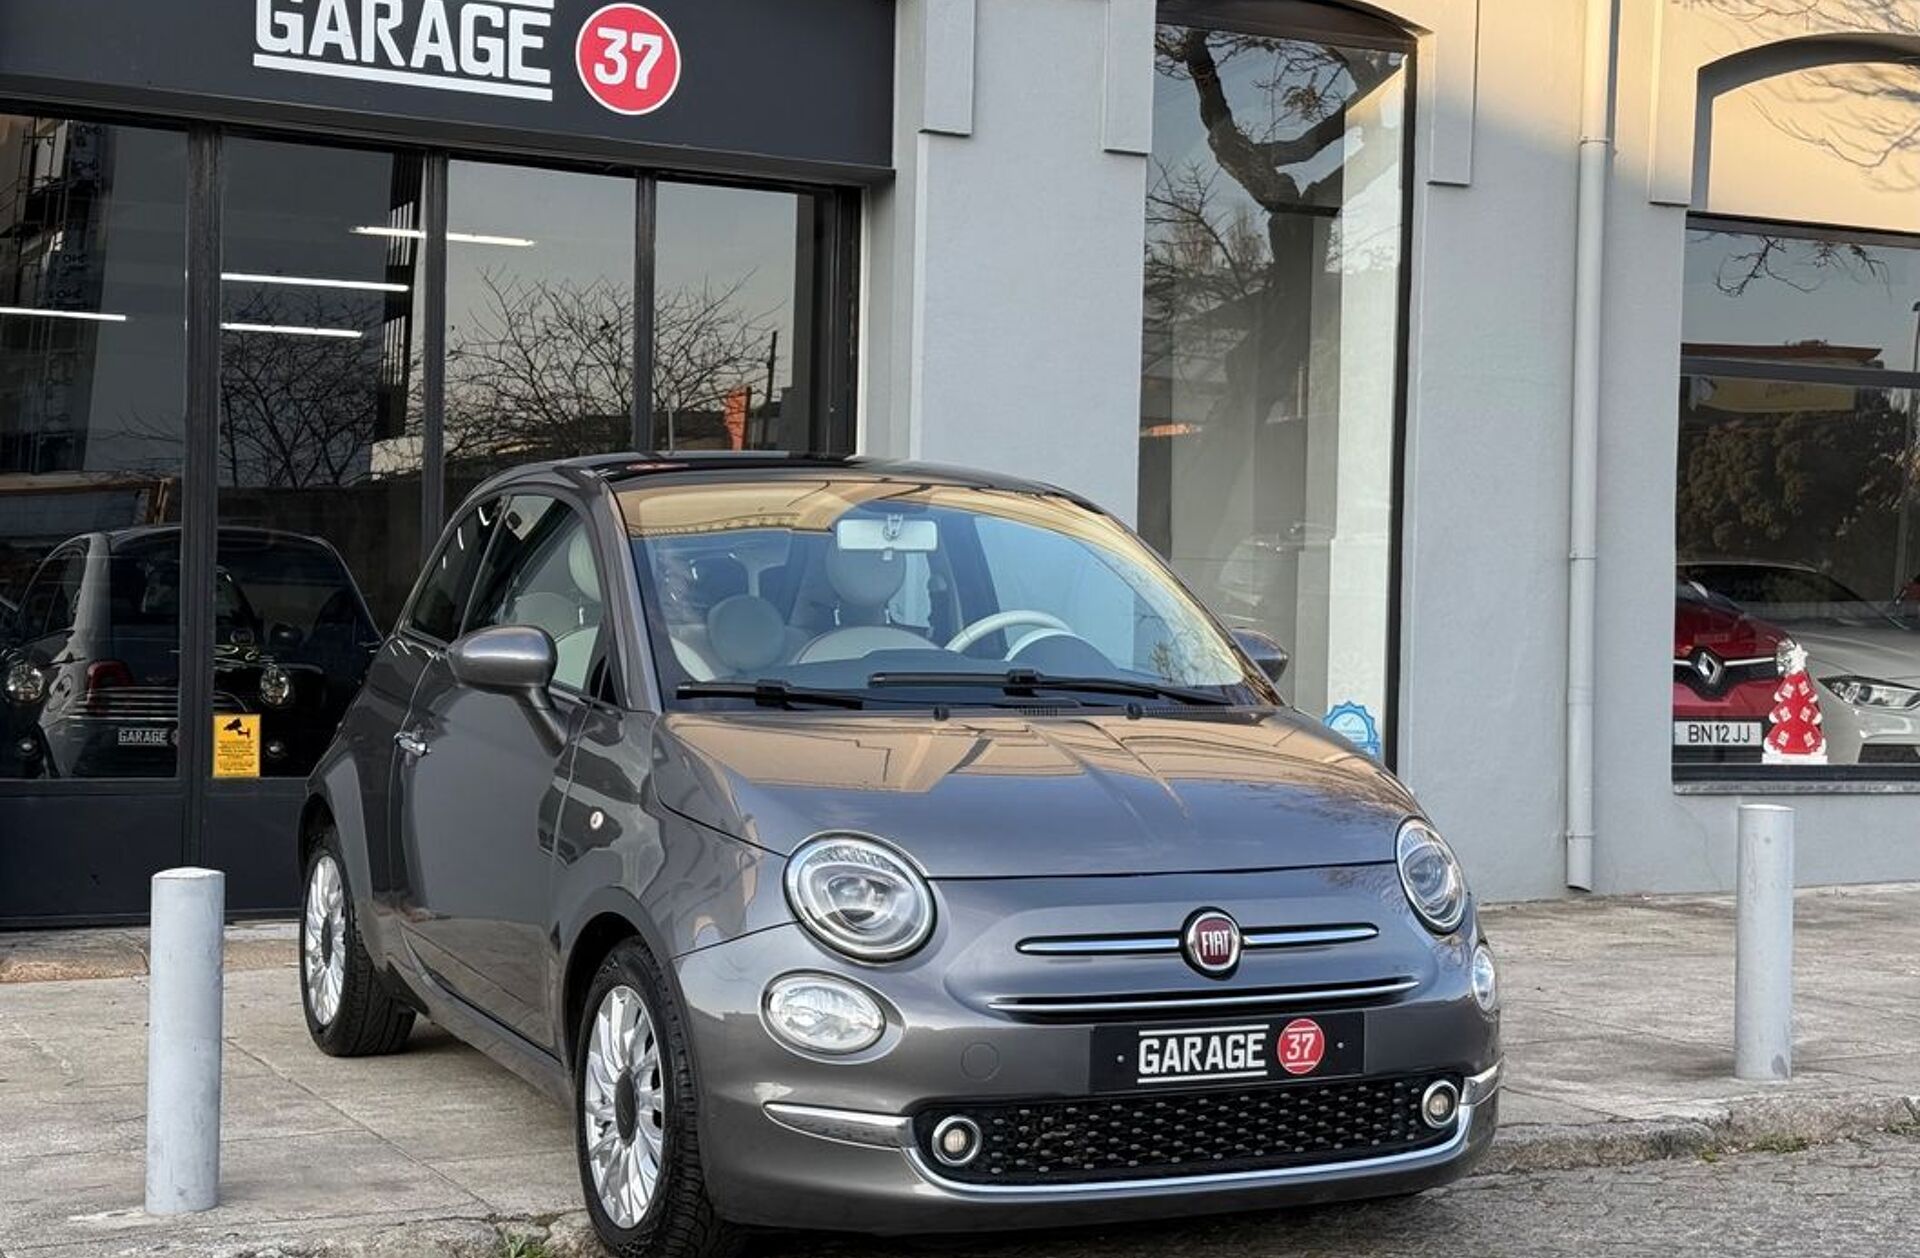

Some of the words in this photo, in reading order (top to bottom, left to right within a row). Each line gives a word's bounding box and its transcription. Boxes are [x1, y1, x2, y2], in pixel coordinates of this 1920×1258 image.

[255, 0, 552, 84] GARAGE
[593, 27, 663, 90] 37
[118, 730, 168, 743] GARAGE
[1201, 930, 1229, 957] FIAT
[1138, 1032, 1266, 1075] GARAGE
[1286, 1032, 1316, 1061] 37
